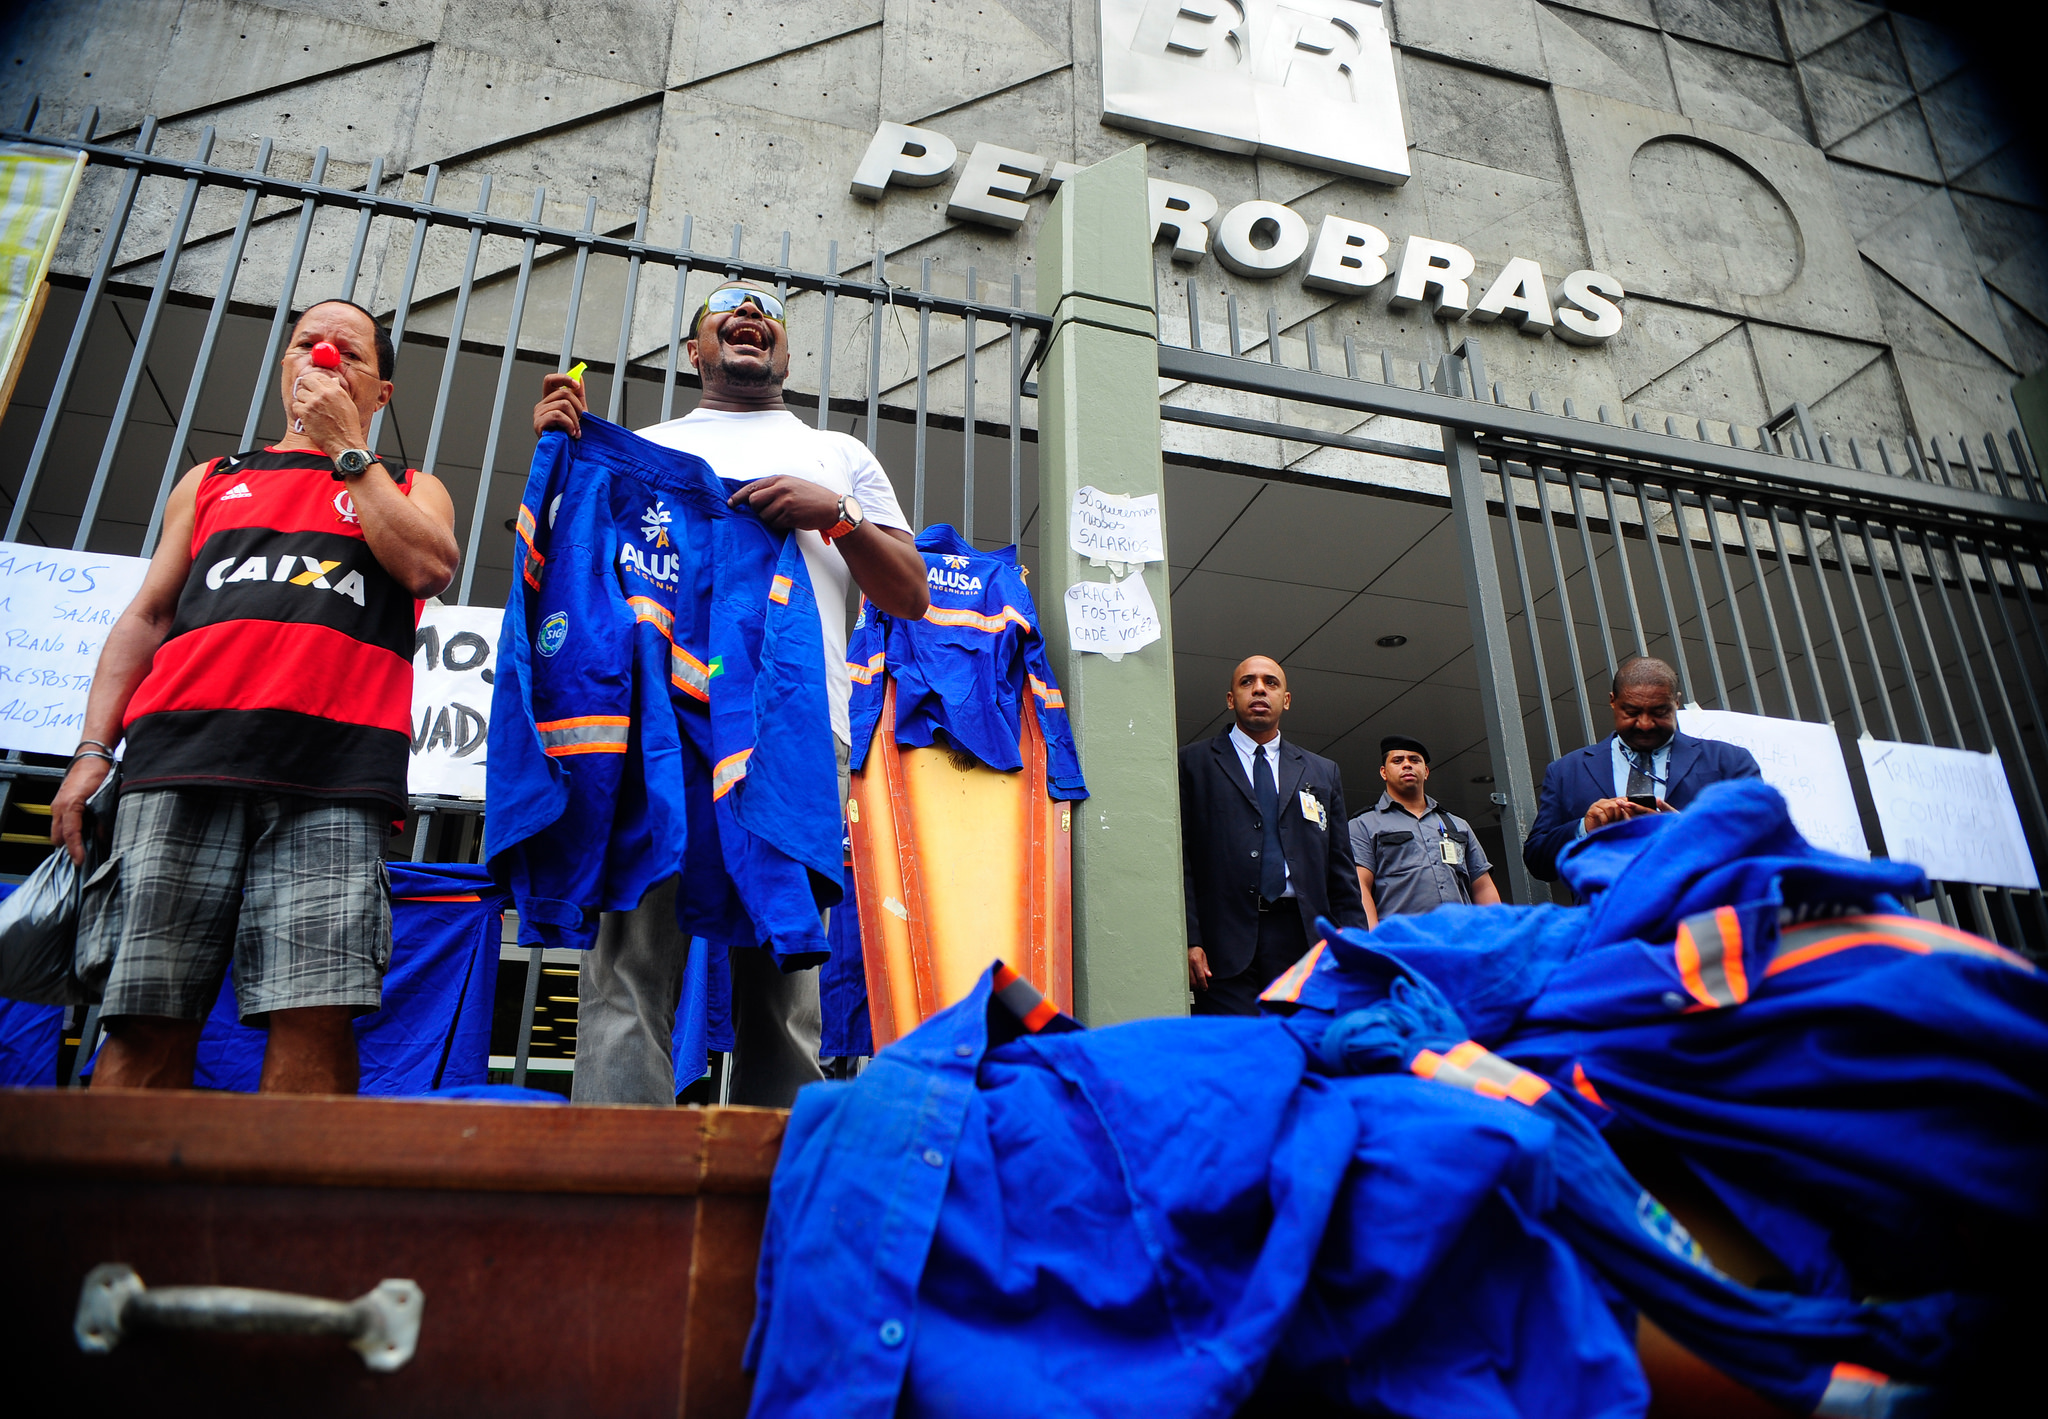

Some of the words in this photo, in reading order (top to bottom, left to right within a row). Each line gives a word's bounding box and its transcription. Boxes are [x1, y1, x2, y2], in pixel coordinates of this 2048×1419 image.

[849, 120, 1625, 346] PEROBRAS
[205, 554, 366, 607] CAIXA
[625, 564, 679, 594] ENGENH
[926, 566, 983, 591] ALUSA
[5, 628, 65, 652] PLANO
